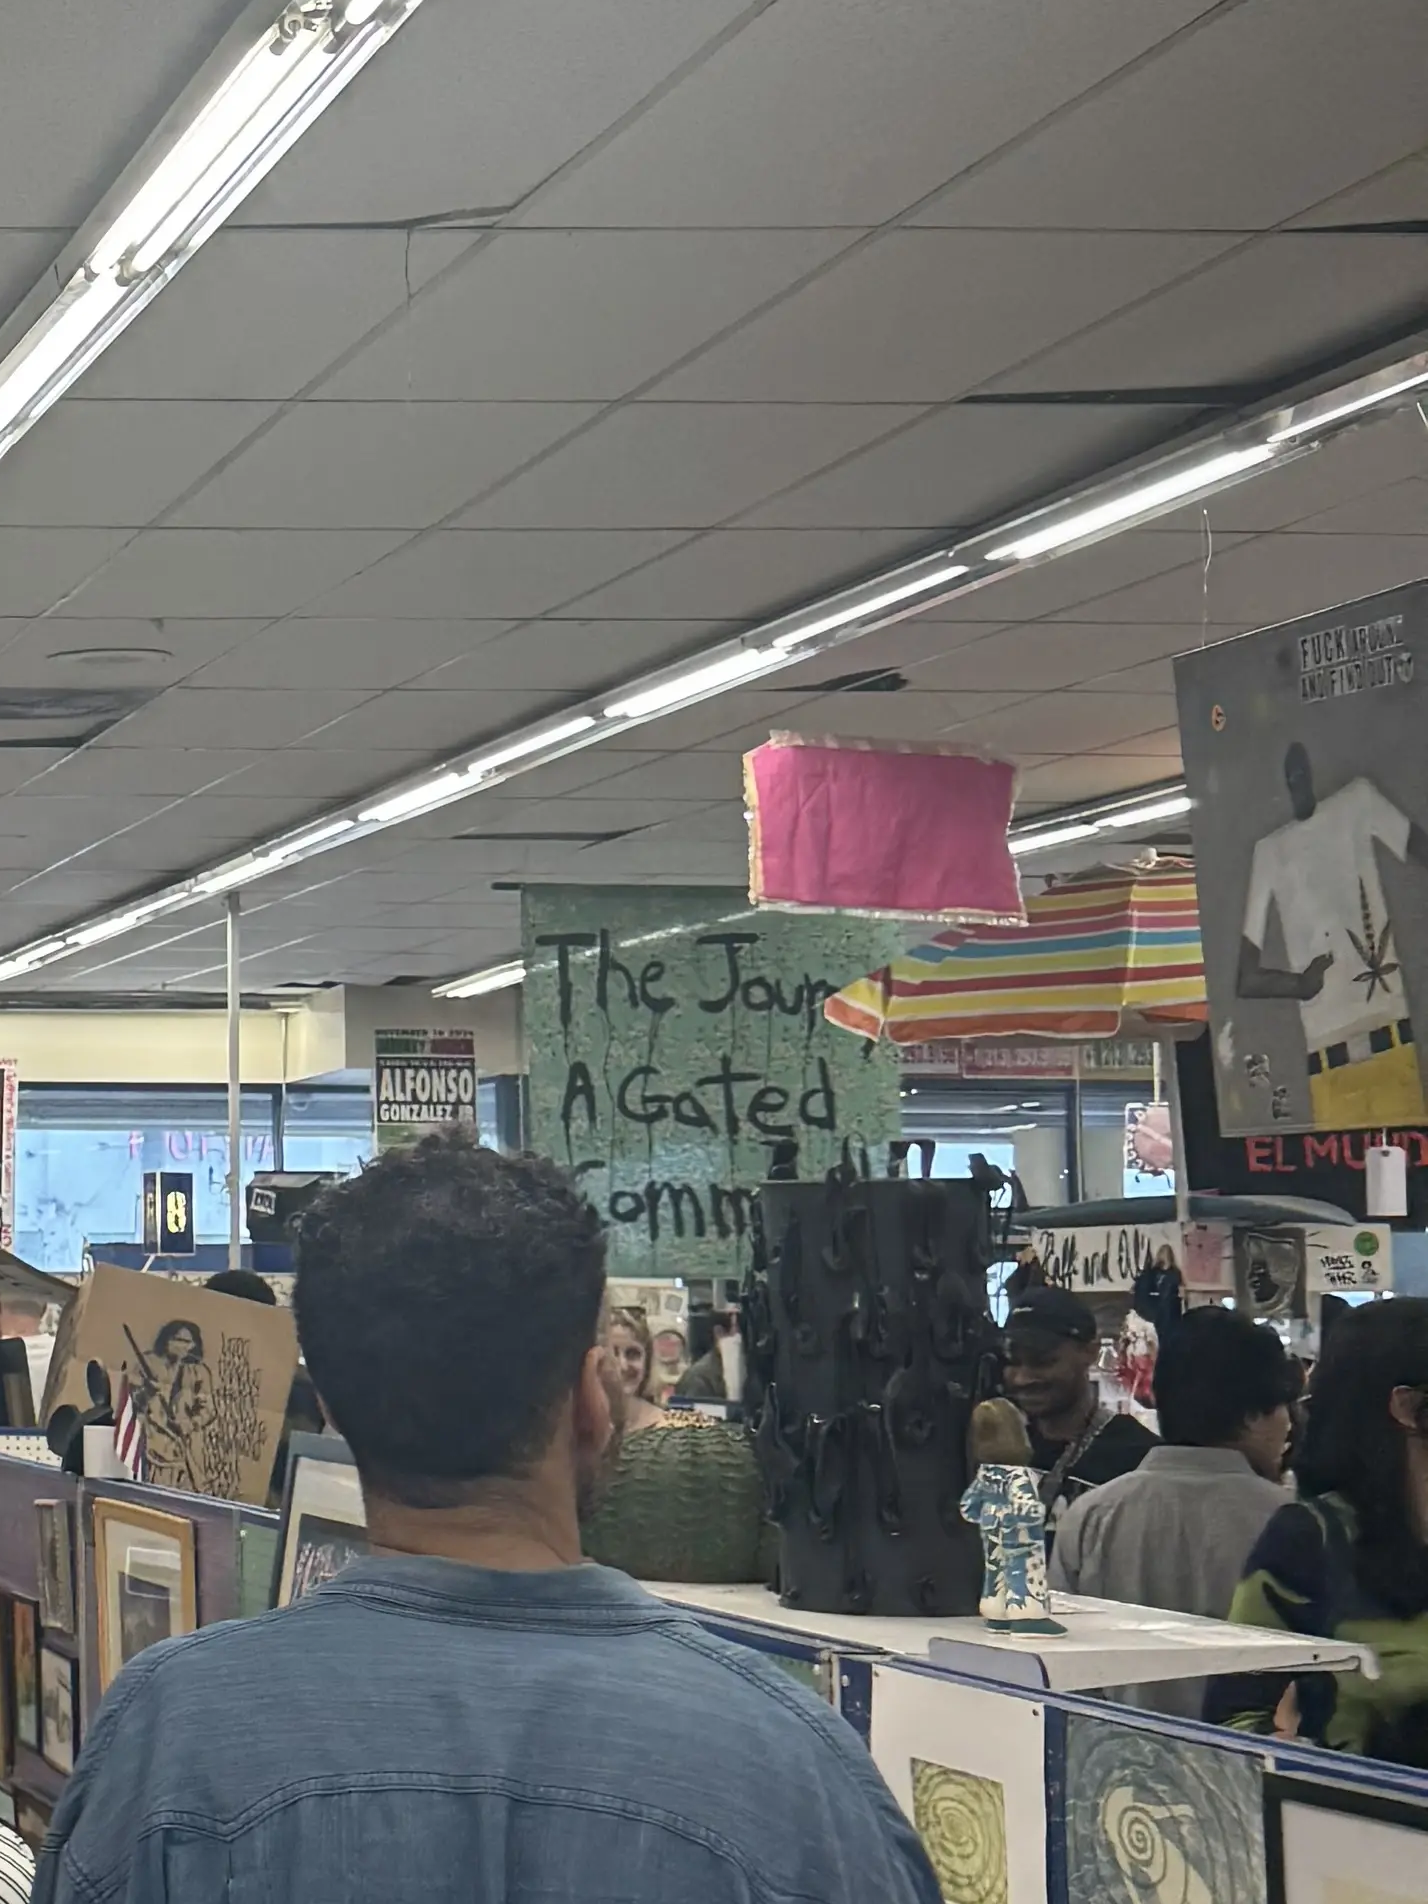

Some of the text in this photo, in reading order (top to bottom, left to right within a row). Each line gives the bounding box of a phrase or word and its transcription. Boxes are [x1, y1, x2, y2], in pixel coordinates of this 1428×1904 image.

[1300, 627, 1345, 670] FUCK
[536, 929, 841, 1028] The Jour
[379, 1067, 474, 1103] ALFONSO
[561, 1055, 836, 1142] A Gated
[379, 1103, 453, 1122] GONZALEZ
[1246, 1130, 1428, 1172] EL MUD
